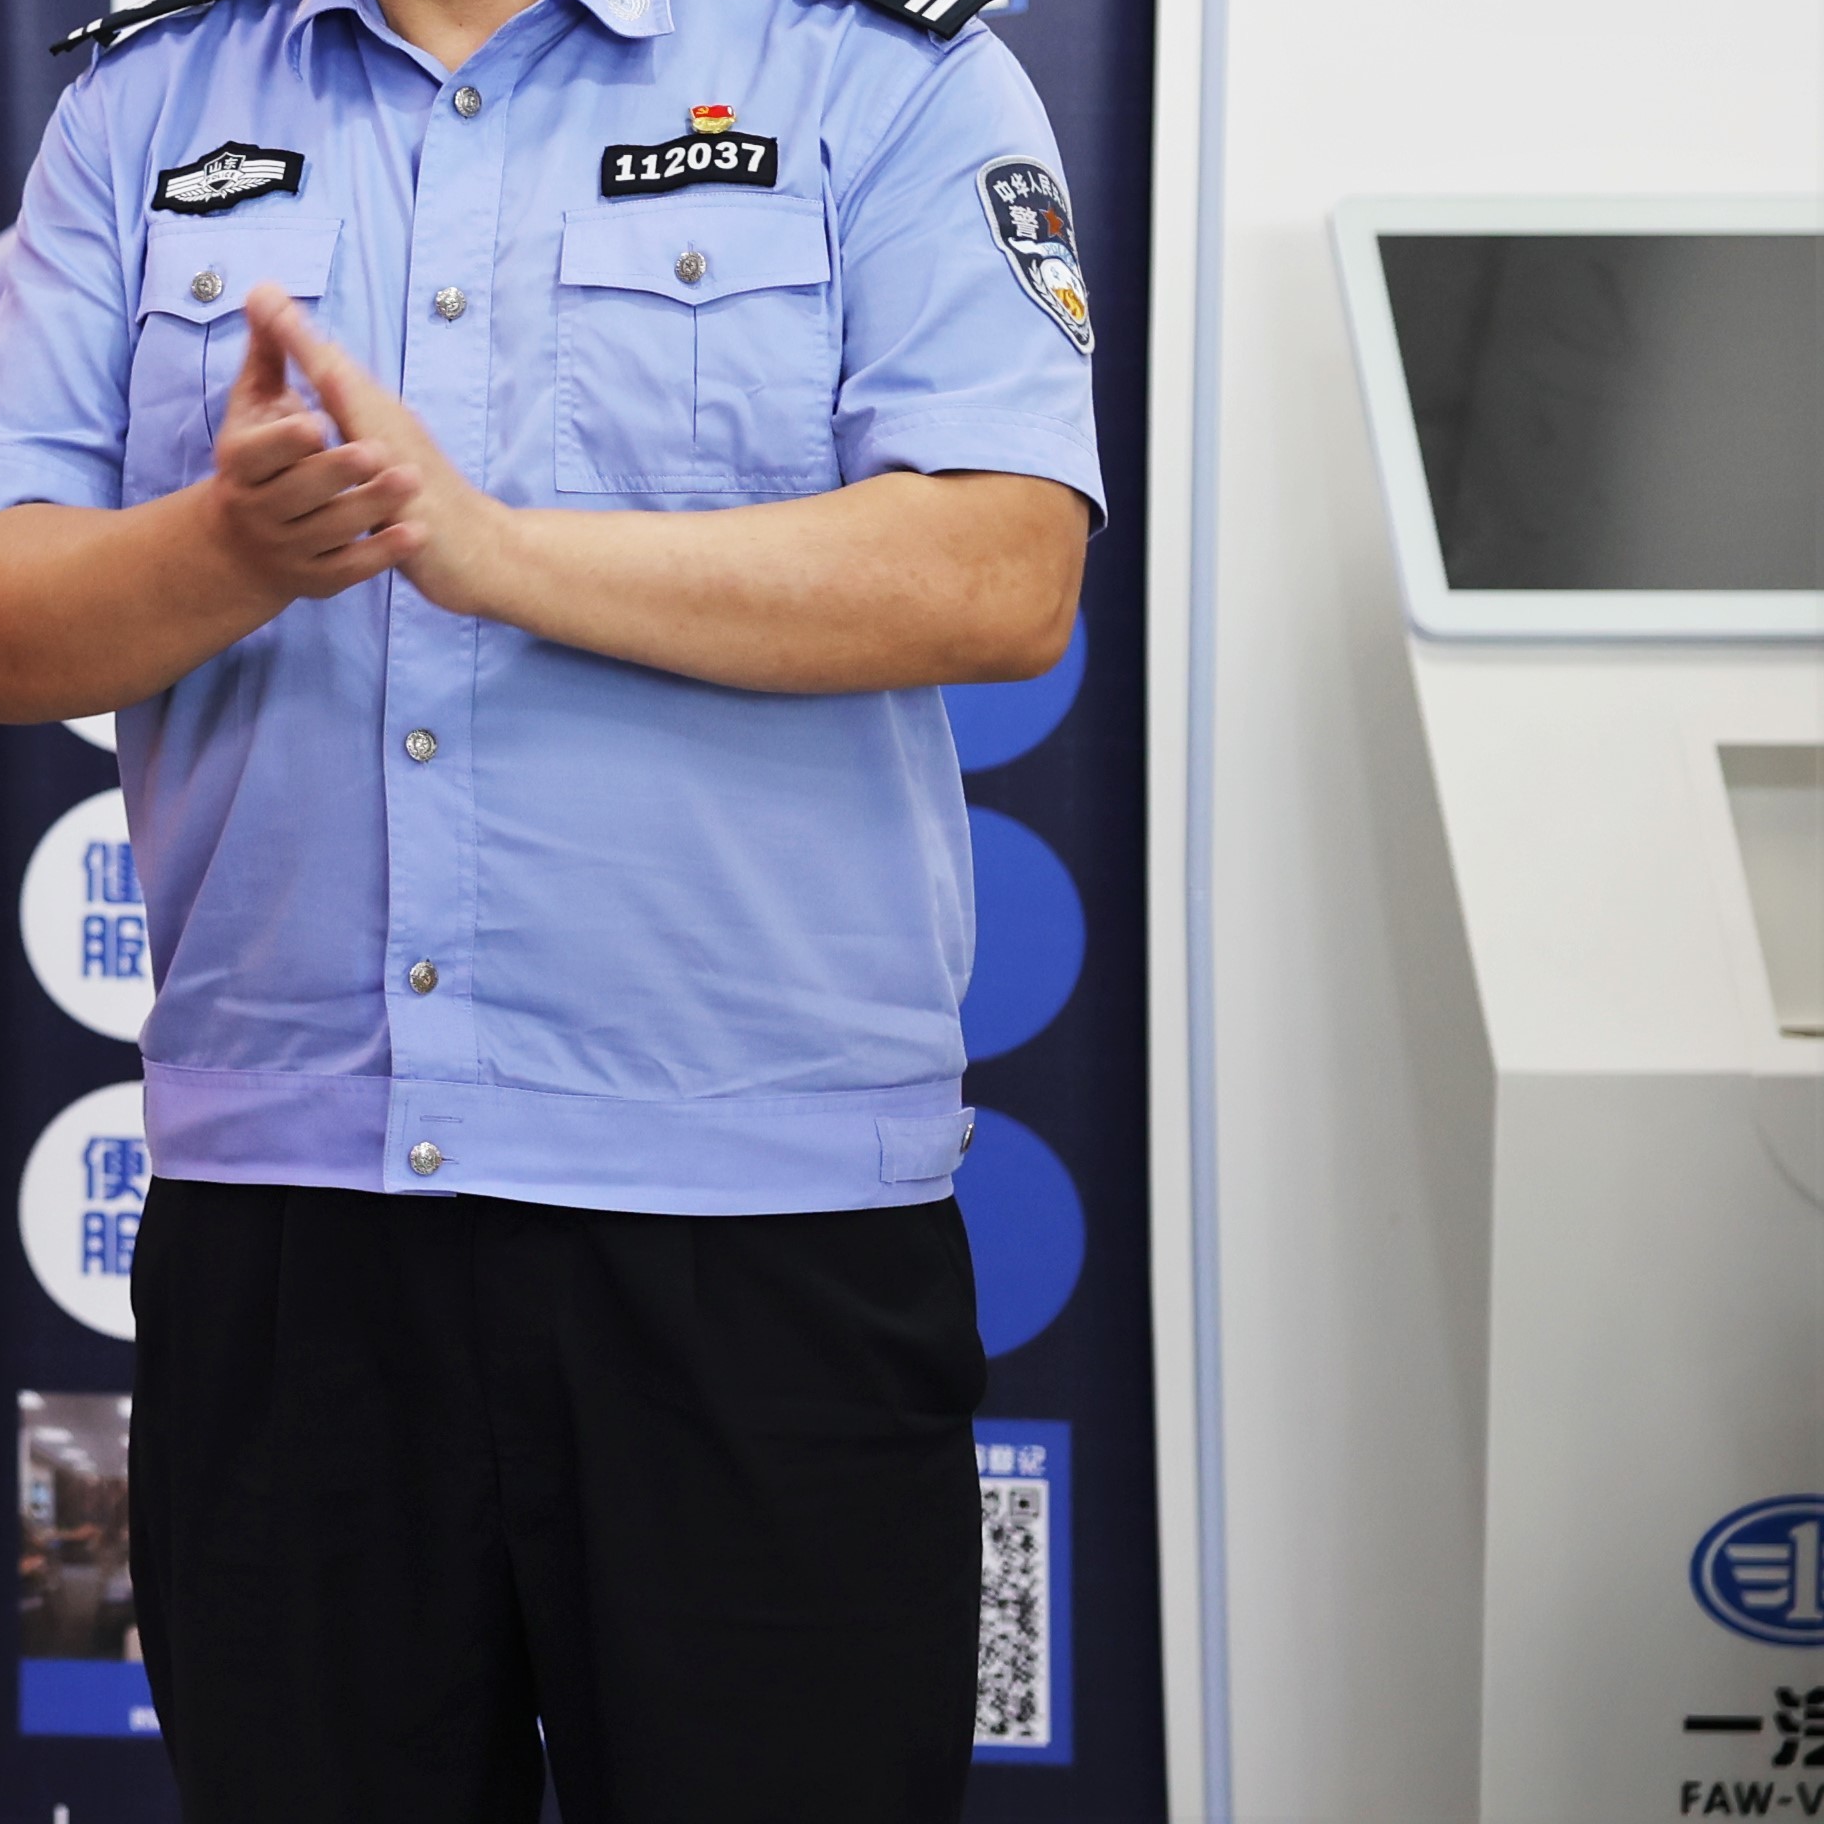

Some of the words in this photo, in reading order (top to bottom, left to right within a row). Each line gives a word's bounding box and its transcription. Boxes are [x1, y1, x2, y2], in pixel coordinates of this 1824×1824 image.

[209, 157, 238, 174] 山东
[614, 141, 766, 182] 112037
[992, 170, 1068, 212] 中华人民
[82, 914, 148, 979] 服
[83, 1137, 148, 1201] 便
